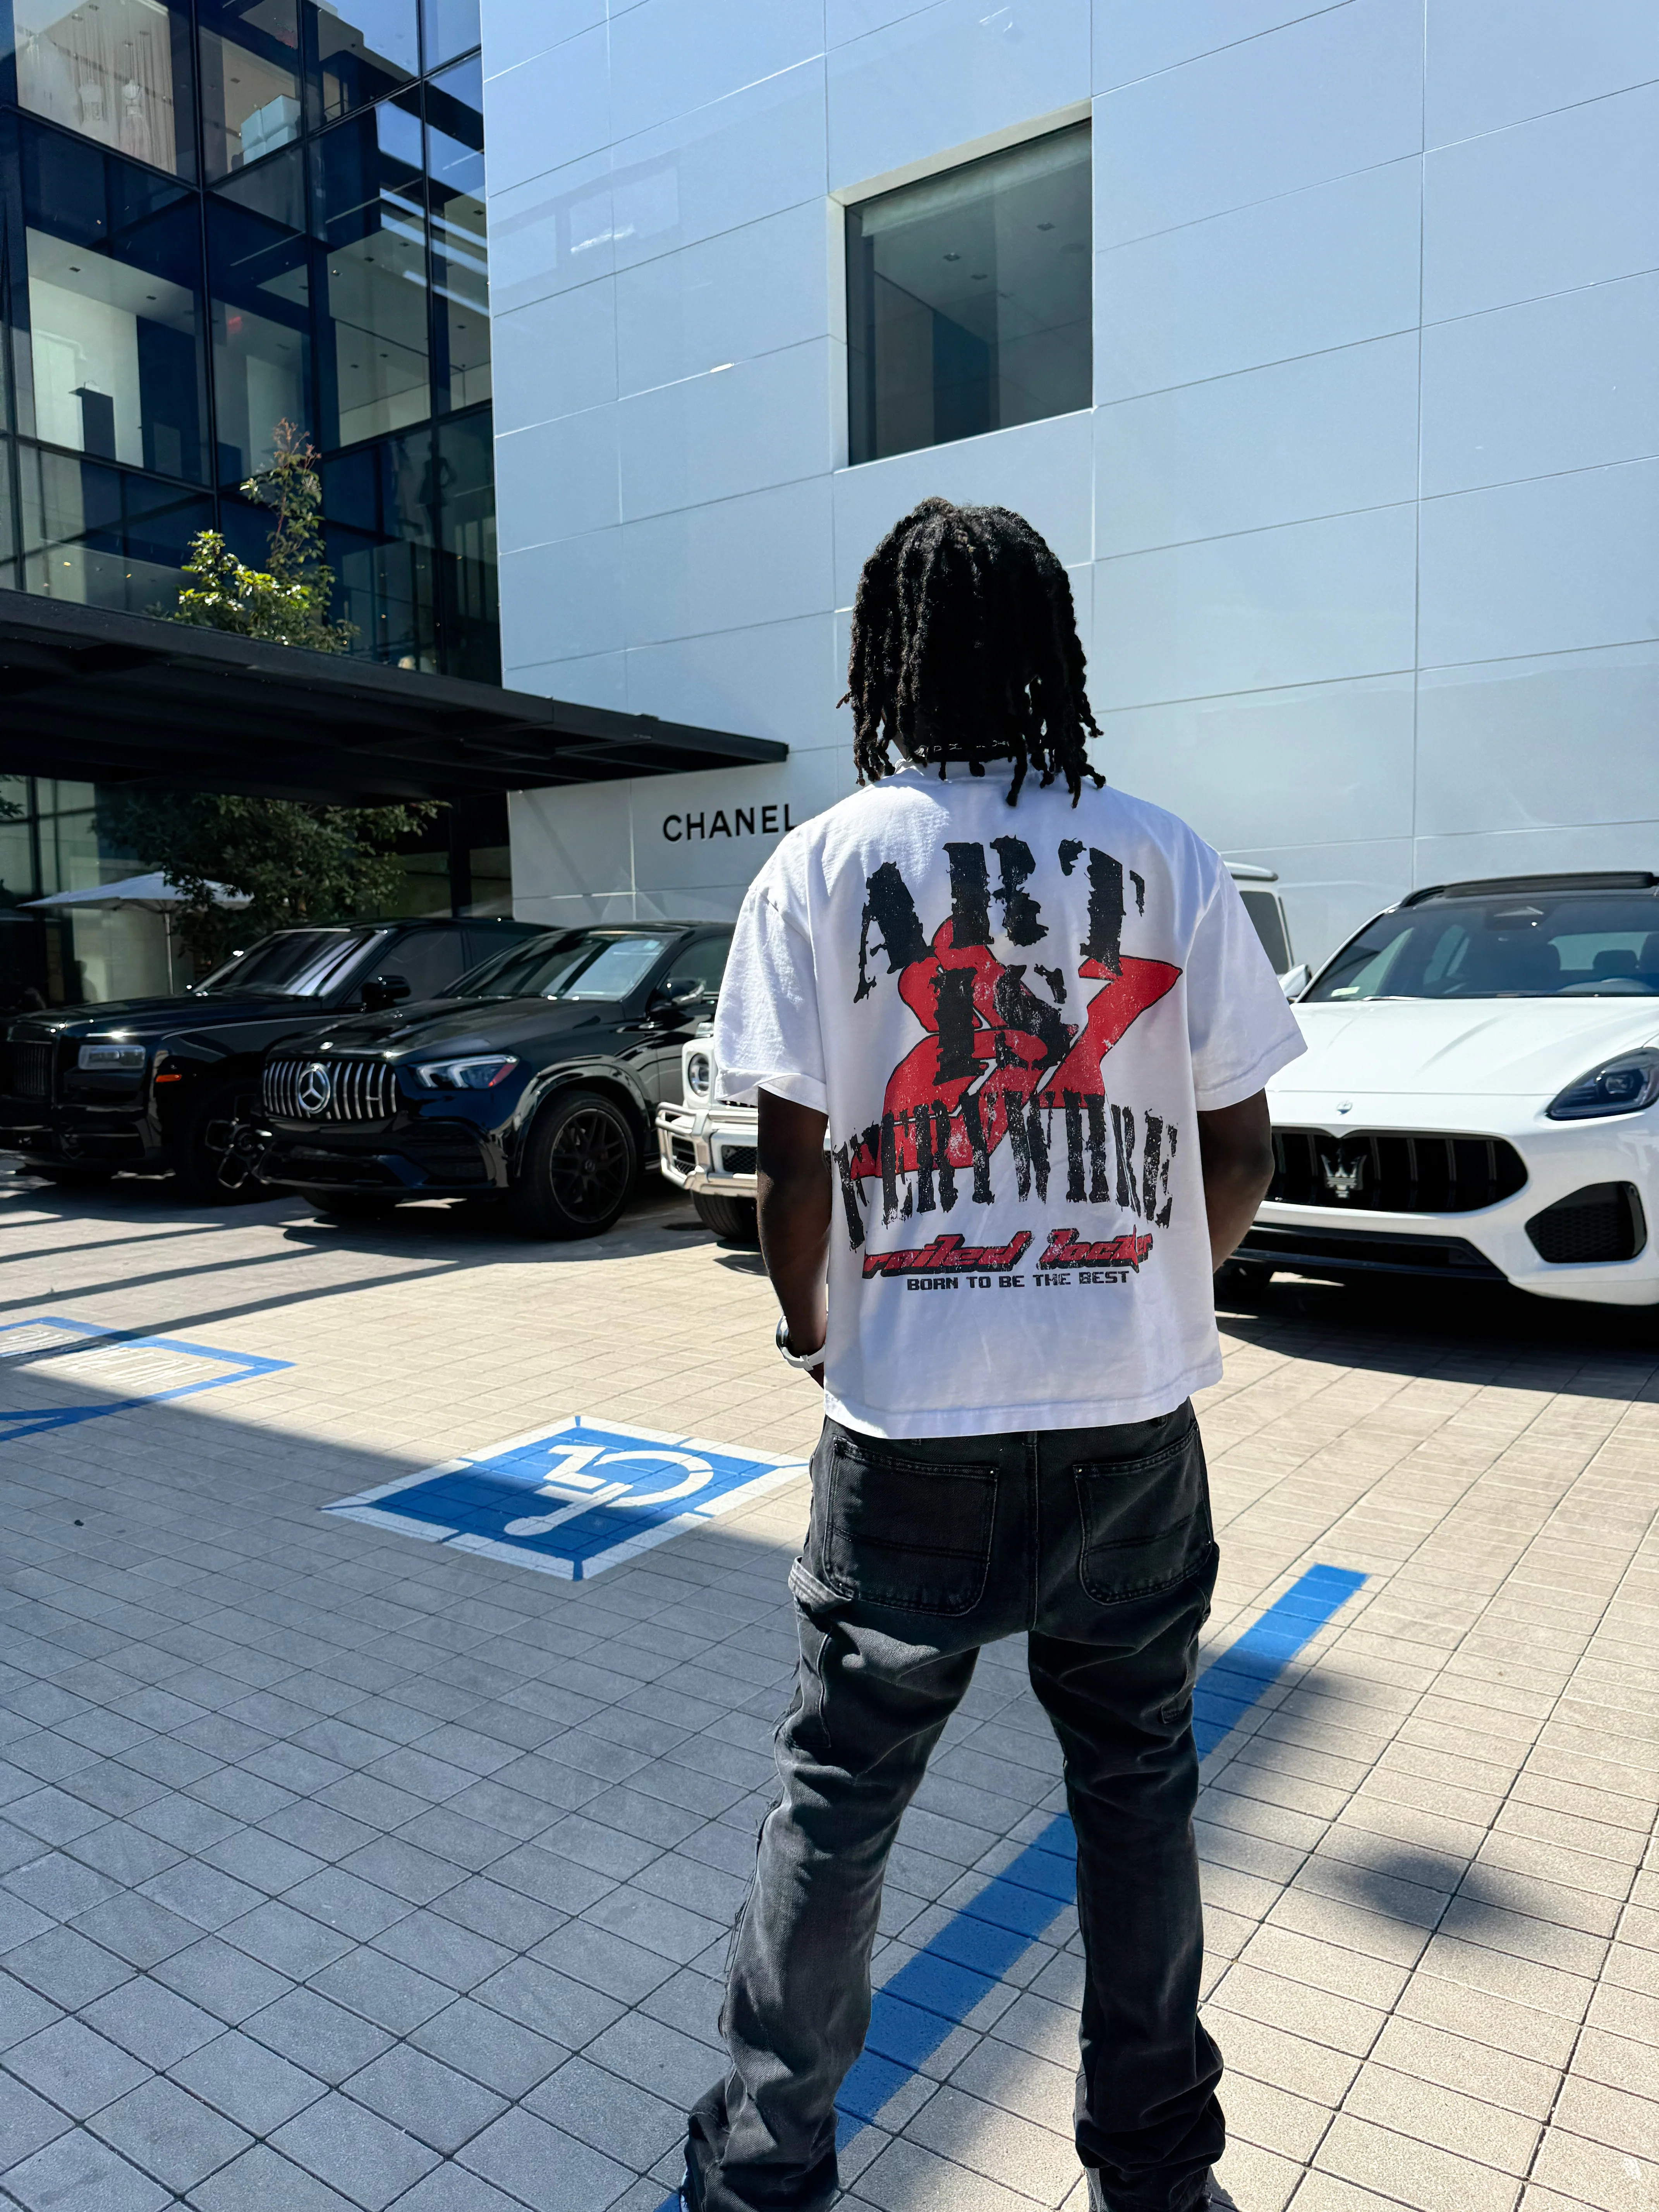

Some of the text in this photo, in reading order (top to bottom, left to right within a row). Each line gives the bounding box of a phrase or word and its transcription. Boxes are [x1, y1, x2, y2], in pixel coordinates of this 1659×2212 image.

[663, 803, 799, 842] CHANEL
[854, 834, 1145, 1004] ART
[928, 963, 1072, 1087] IS
[833, 1087, 1178, 1254] EERYWHRE
[907, 1271, 1129, 1291] BORN TO BE THE BEST
